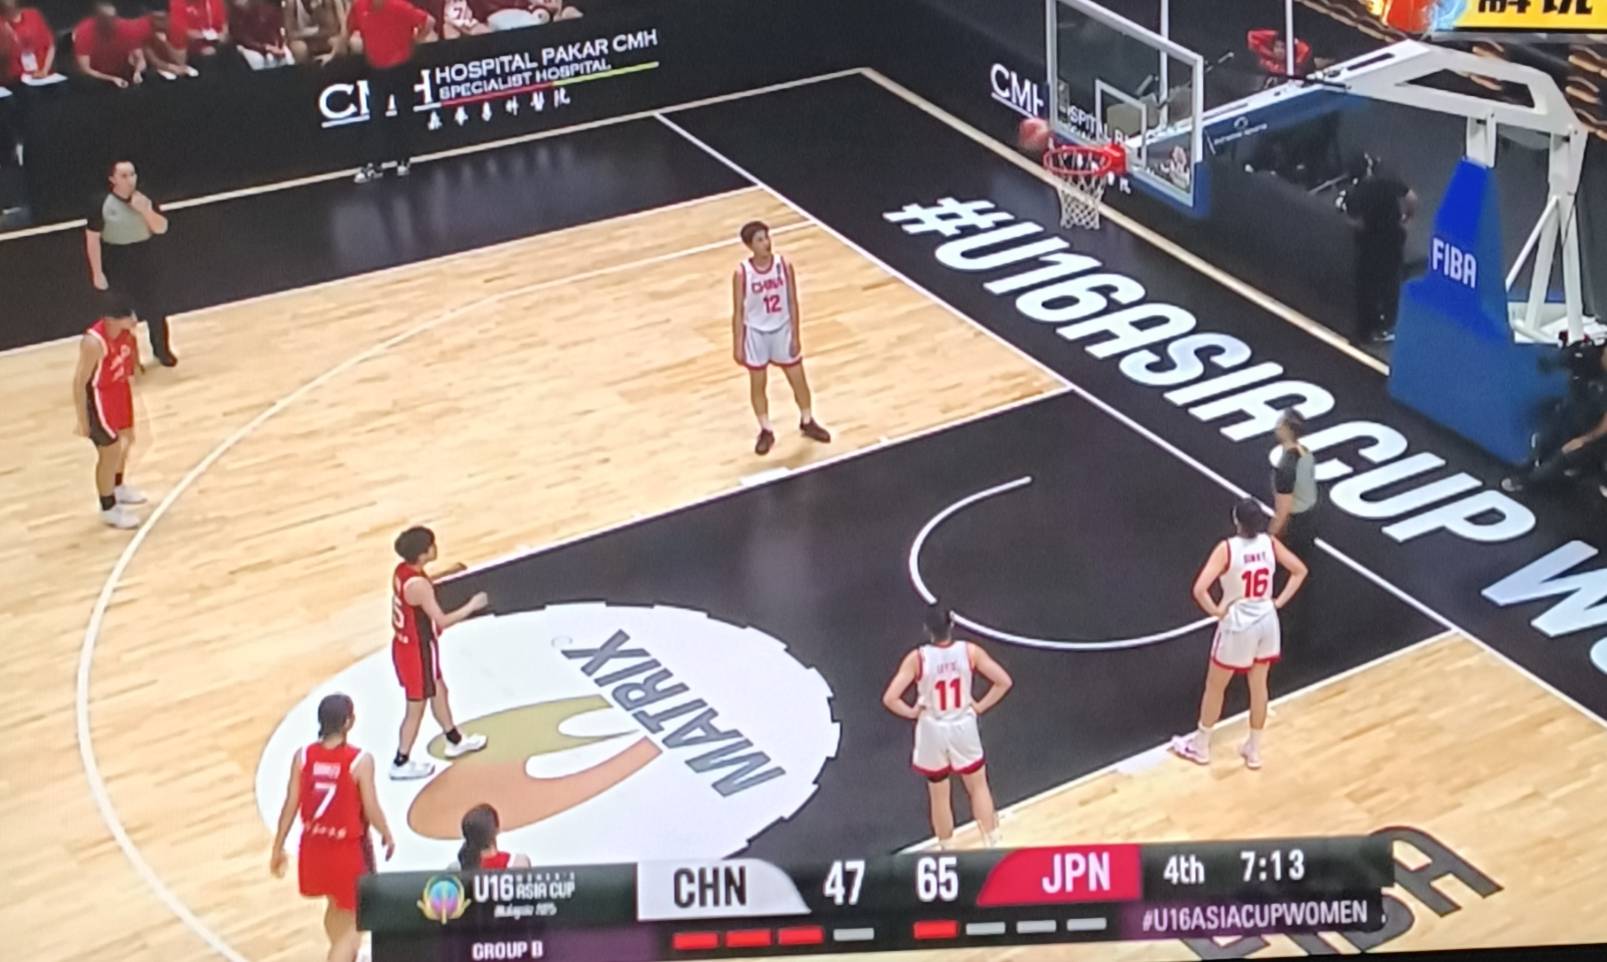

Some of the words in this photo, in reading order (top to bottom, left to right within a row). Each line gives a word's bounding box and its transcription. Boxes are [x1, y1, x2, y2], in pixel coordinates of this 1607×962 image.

[435, 50, 538, 84] HOSPITAL
[541, 38, 608, 66] PAKAR
[612, 29, 658, 52] CMH
[438, 71, 532, 100] SPECIALIST
[536, 61, 612, 83] HOSPITAL
[1432, 237, 1477, 289] FIBA
[763, 294, 782, 314] 12
[1241, 567, 1270, 598] 16
[934, 677, 962, 712] 11
[560, 629, 787, 798] MATRIX
[313, 783, 338, 819] 7
[823, 860, 867, 906] 47
[916, 856, 960, 904] 65
[1041, 852, 1112, 894] JPN
[1163, 854, 1205, 886] 4th
[1240, 851, 1306, 882] 7:13
[473, 874, 515, 903] U16
[516, 882, 547, 900] ASIA
[549, 880, 576, 900] CUP
[672, 866, 749, 909] CHN
[1142, 901, 1368, 934] #U16ASIACUPWOMEN
[471, 943, 528, 961] GROUP
